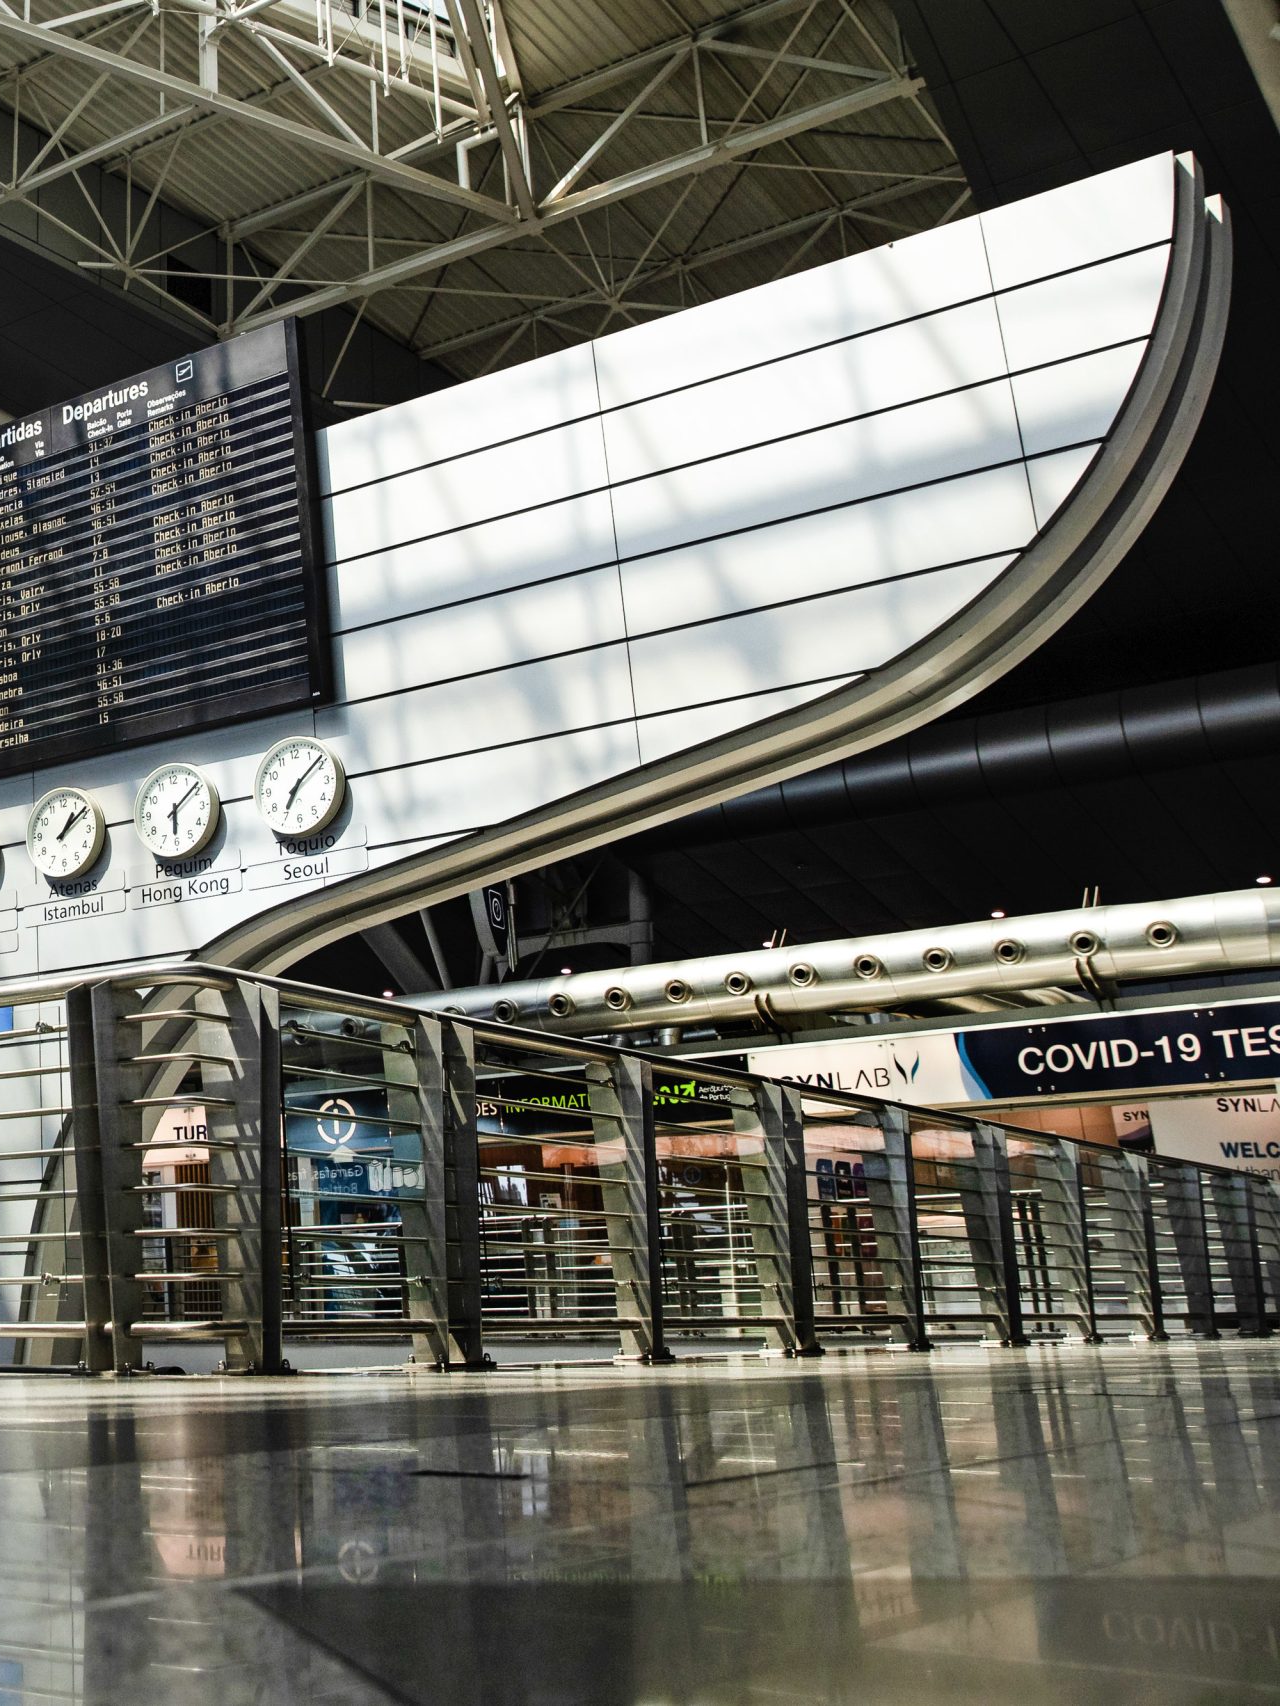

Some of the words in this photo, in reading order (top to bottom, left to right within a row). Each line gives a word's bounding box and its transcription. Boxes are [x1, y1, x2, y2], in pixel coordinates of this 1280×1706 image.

[62, 381, 149, 425] Departures
[116, 408, 132, 420] Porta
[147, 403, 174, 417] Remarks
[148, 408, 190, 433] Check-in
[195, 395, 227, 416] Aberto
[26, 468, 64, 490] Stansted
[149, 424, 191, 448] Check-in
[195, 411, 228, 432] Aberto
[149, 440, 191, 464] Check-in
[196, 427, 229, 448] Aberto
[32, 514, 66, 534] Blagnac
[151, 472, 193, 496] Check-in
[198, 459, 231, 480] Aberto
[28, 546, 62, 566] Ferrand
[20, 600, 39, 616] Orly
[21, 632, 40, 647] Orly
[156, 586, 199, 609] Check-in
[204, 575, 237, 595] Aberto
[21, 647, 40, 663] Orly
[276, 834, 336, 856] Tóquio
[155, 856, 213, 879] Pequim
[284, 857, 329, 880] Seoul
[49, 879, 98, 899] Atenas
[141, 884, 182, 904] Hong
[188, 877, 229, 896] Kong
[44, 896, 104, 921] Istambul
[1018, 1033, 1202, 1076] COVID-19
[781, 1067, 890, 1090] YNLAB
[173, 1125, 207, 1140] TUR
